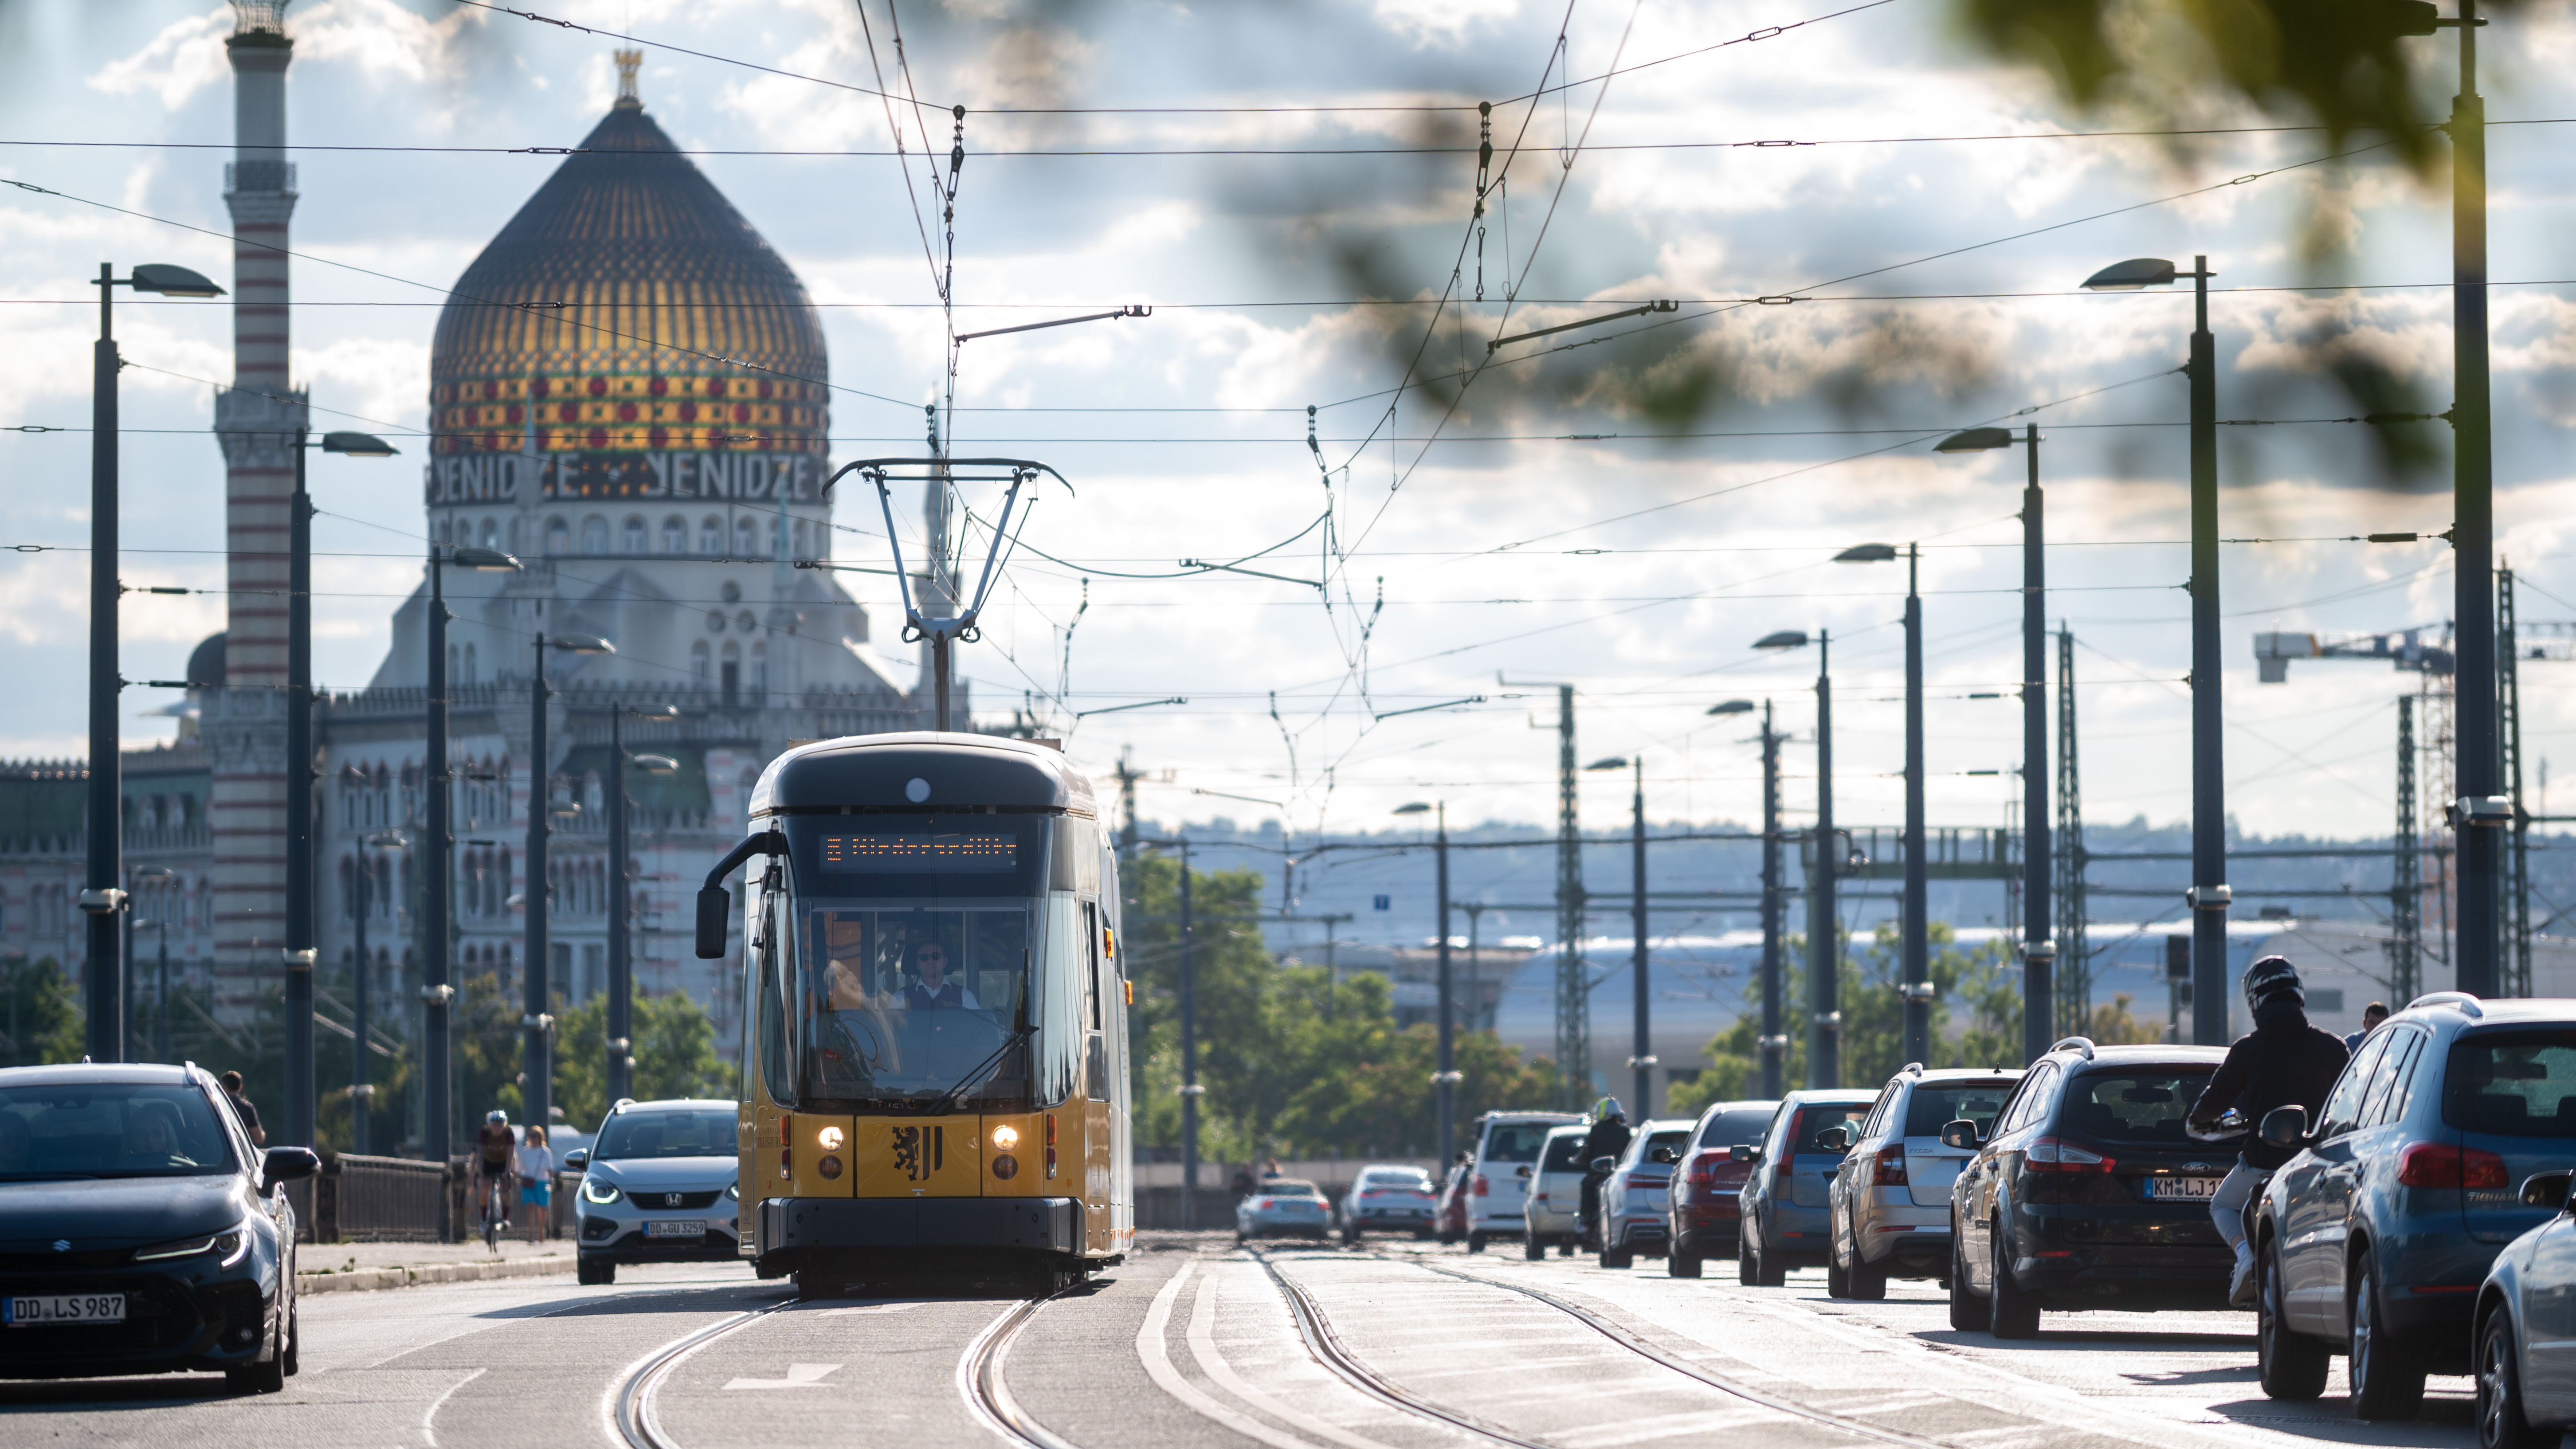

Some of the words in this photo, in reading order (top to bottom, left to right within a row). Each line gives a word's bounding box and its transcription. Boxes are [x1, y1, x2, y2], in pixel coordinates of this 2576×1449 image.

[643, 451, 808, 499] YENIDZE
[2154, 1179, 2173, 1195] KM
[2185, 1180, 2204, 1195] LJ
[2209, 1180, 2221, 1195] 1
[2467, 1192, 2517, 1202] TIGUAN
[650, 1223, 661, 1234] DD
[668, 1223, 679, 1233] GU
[681, 1223, 704, 1233] 3259
[15, 1300, 40, 1319] DD
[55, 1298, 81, 1318] LS
[86, 1297, 122, 1317] 987
